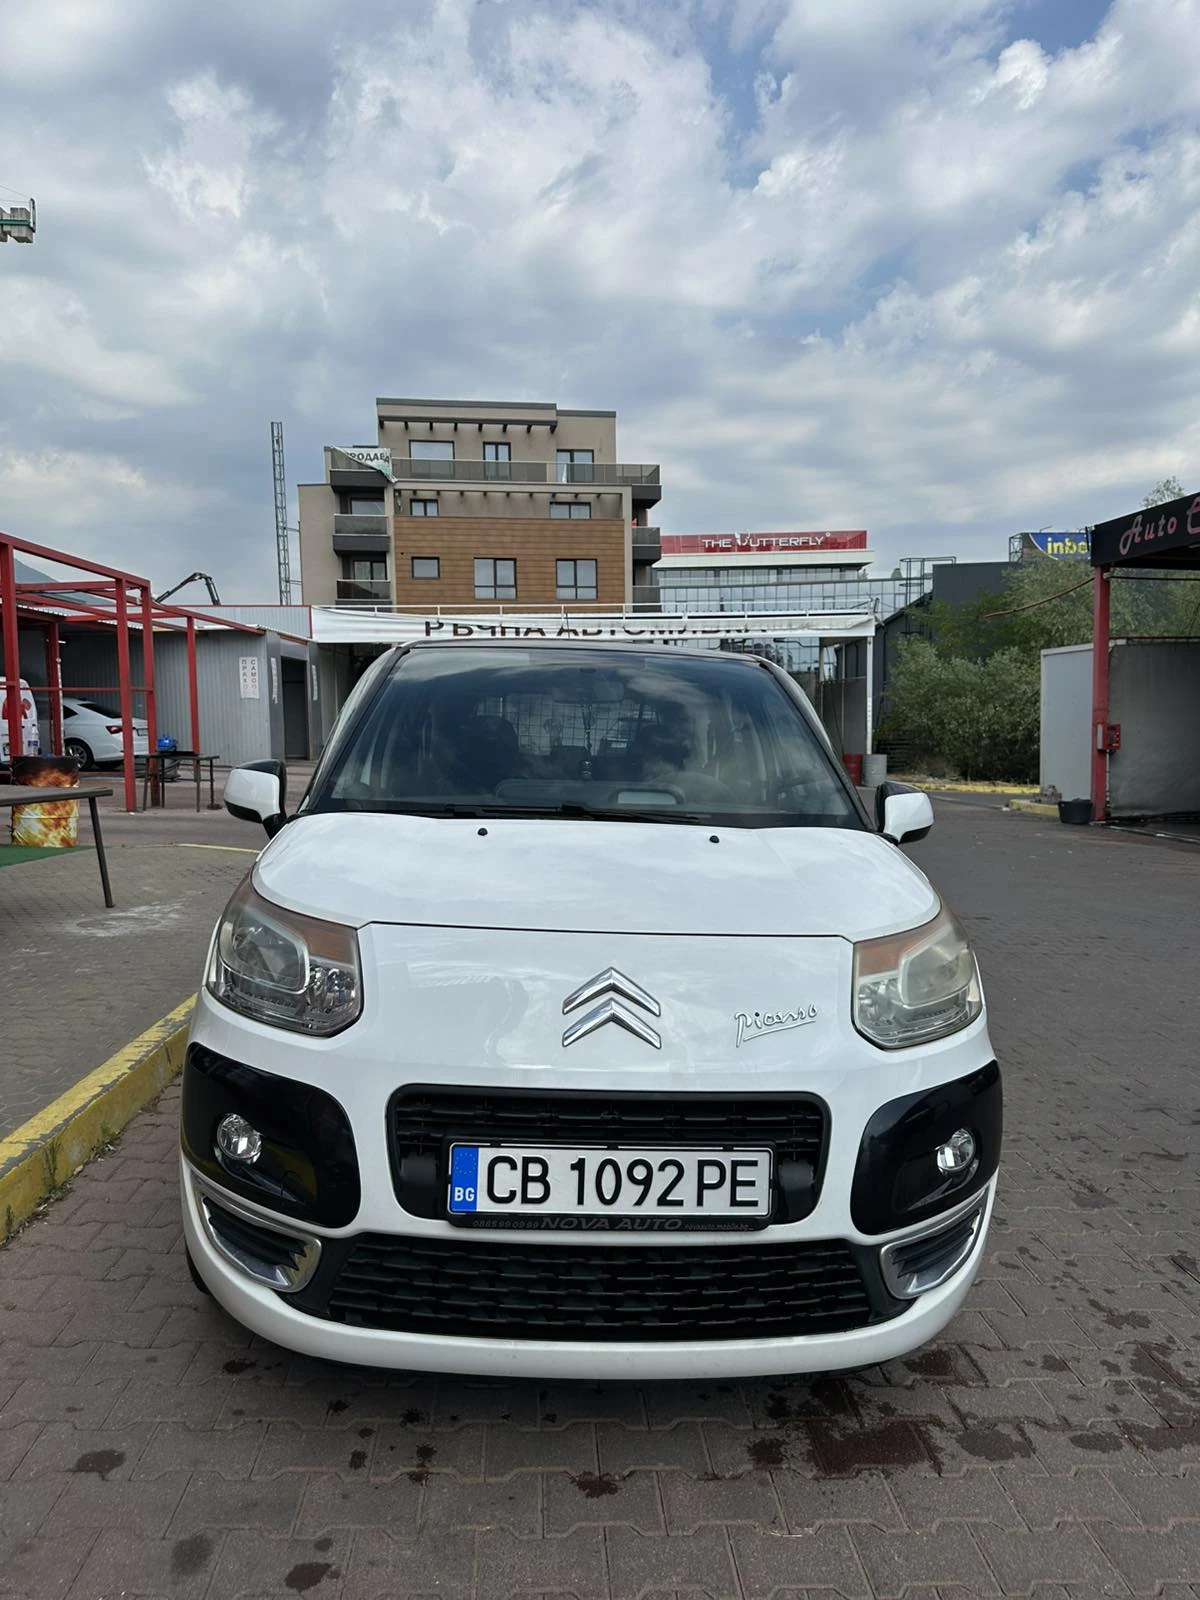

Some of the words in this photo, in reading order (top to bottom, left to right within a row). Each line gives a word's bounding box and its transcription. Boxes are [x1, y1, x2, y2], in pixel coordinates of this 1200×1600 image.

[702, 539, 732, 548] THE
[1119, 514, 1177, 556] Auto
[734, 1003, 818, 1048] Picasso
[454, 1187, 475, 1202] BG
[487, 1155, 551, 1204] CB
[570, 1157, 685, 1207] 1092
[696, 1159, 759, 1207] PE
[540, 1217, 610, 1230] NOVA
[615, 1218, 682, 1230] AUTO
